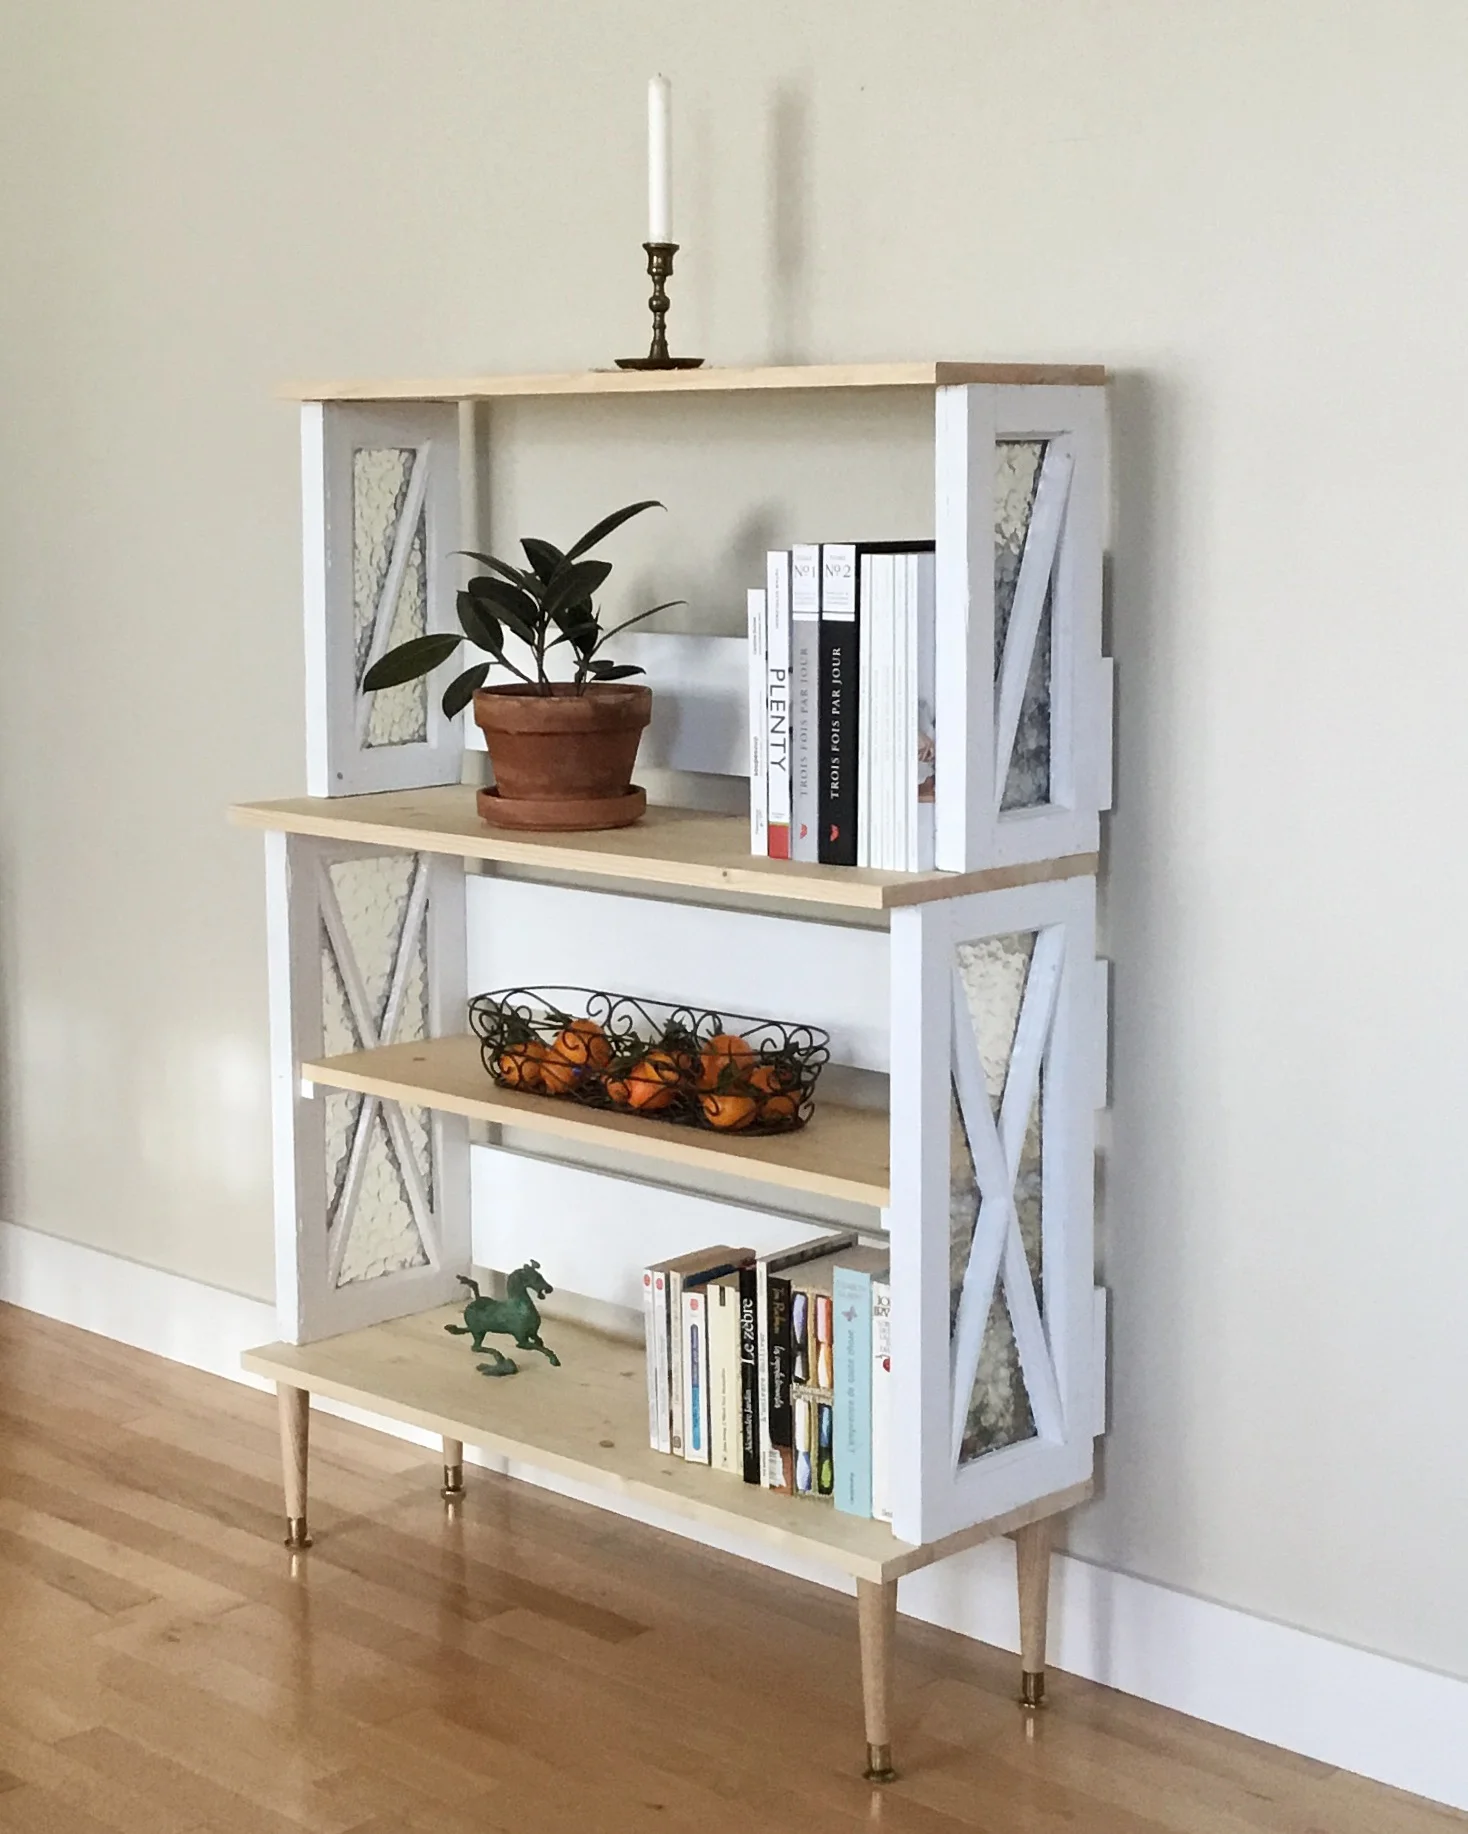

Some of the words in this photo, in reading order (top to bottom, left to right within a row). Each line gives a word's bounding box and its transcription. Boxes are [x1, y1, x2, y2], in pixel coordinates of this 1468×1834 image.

[799, 647, 808, 683] JOUR
[832, 647, 842, 685] JOUR
[799, 688, 808, 714] PAR
[831, 689, 841, 715] PAR
[770, 668, 786, 772] PLENTY
[799, 719, 809, 751] FOIS
[831, 720, 841, 752] FOIS
[799, 756, 809, 798] TROIS
[830, 757, 840, 799] TROIS
[740, 1298, 754, 1341] zèbre
[741, 1343, 755, 1366] Le
